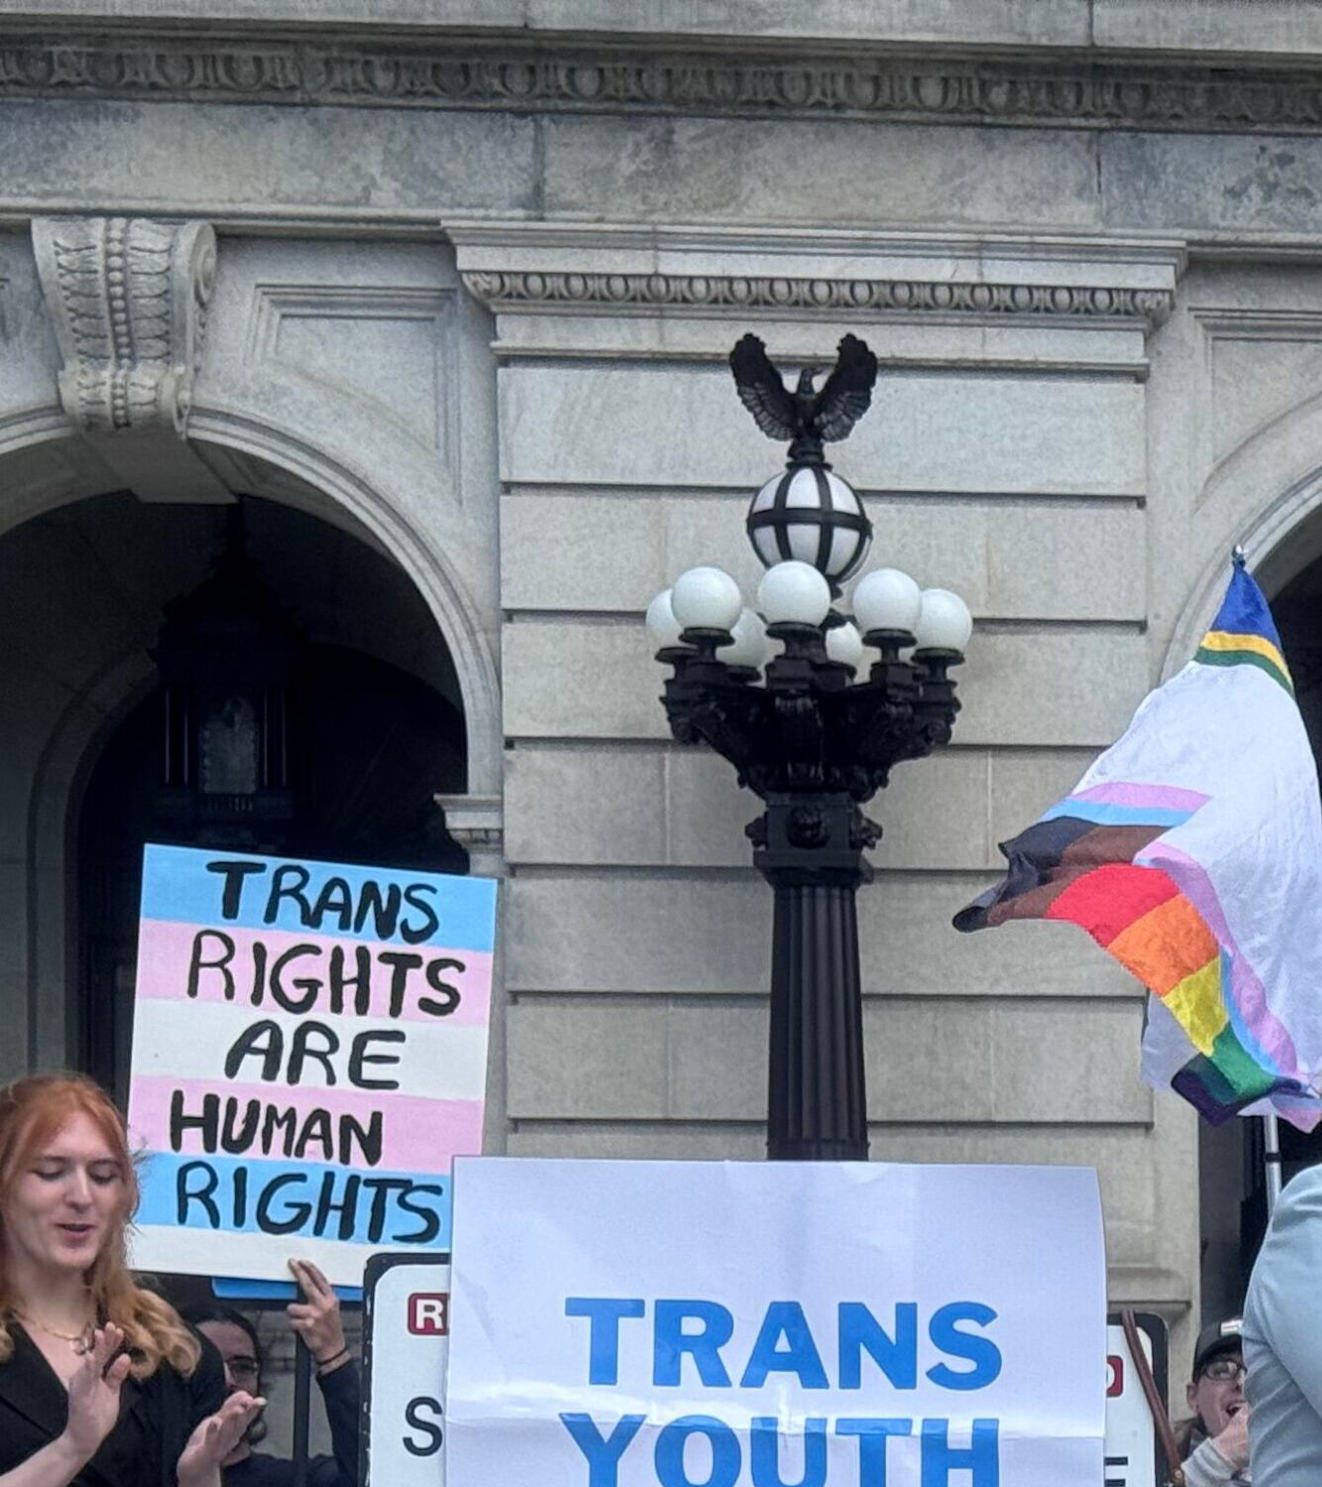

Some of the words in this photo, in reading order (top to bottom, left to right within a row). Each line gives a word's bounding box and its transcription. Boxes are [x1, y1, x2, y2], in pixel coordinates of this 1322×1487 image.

[206, 860, 439, 944] TRANS
[187, 929, 466, 1018] RIGHTS
[224, 1019, 406, 1090] ARE
[169, 1090, 383, 1167] HUMAN
[176, 1161, 443, 1244] RIGHTS
[565, 1297, 1002, 1391] TRANS
